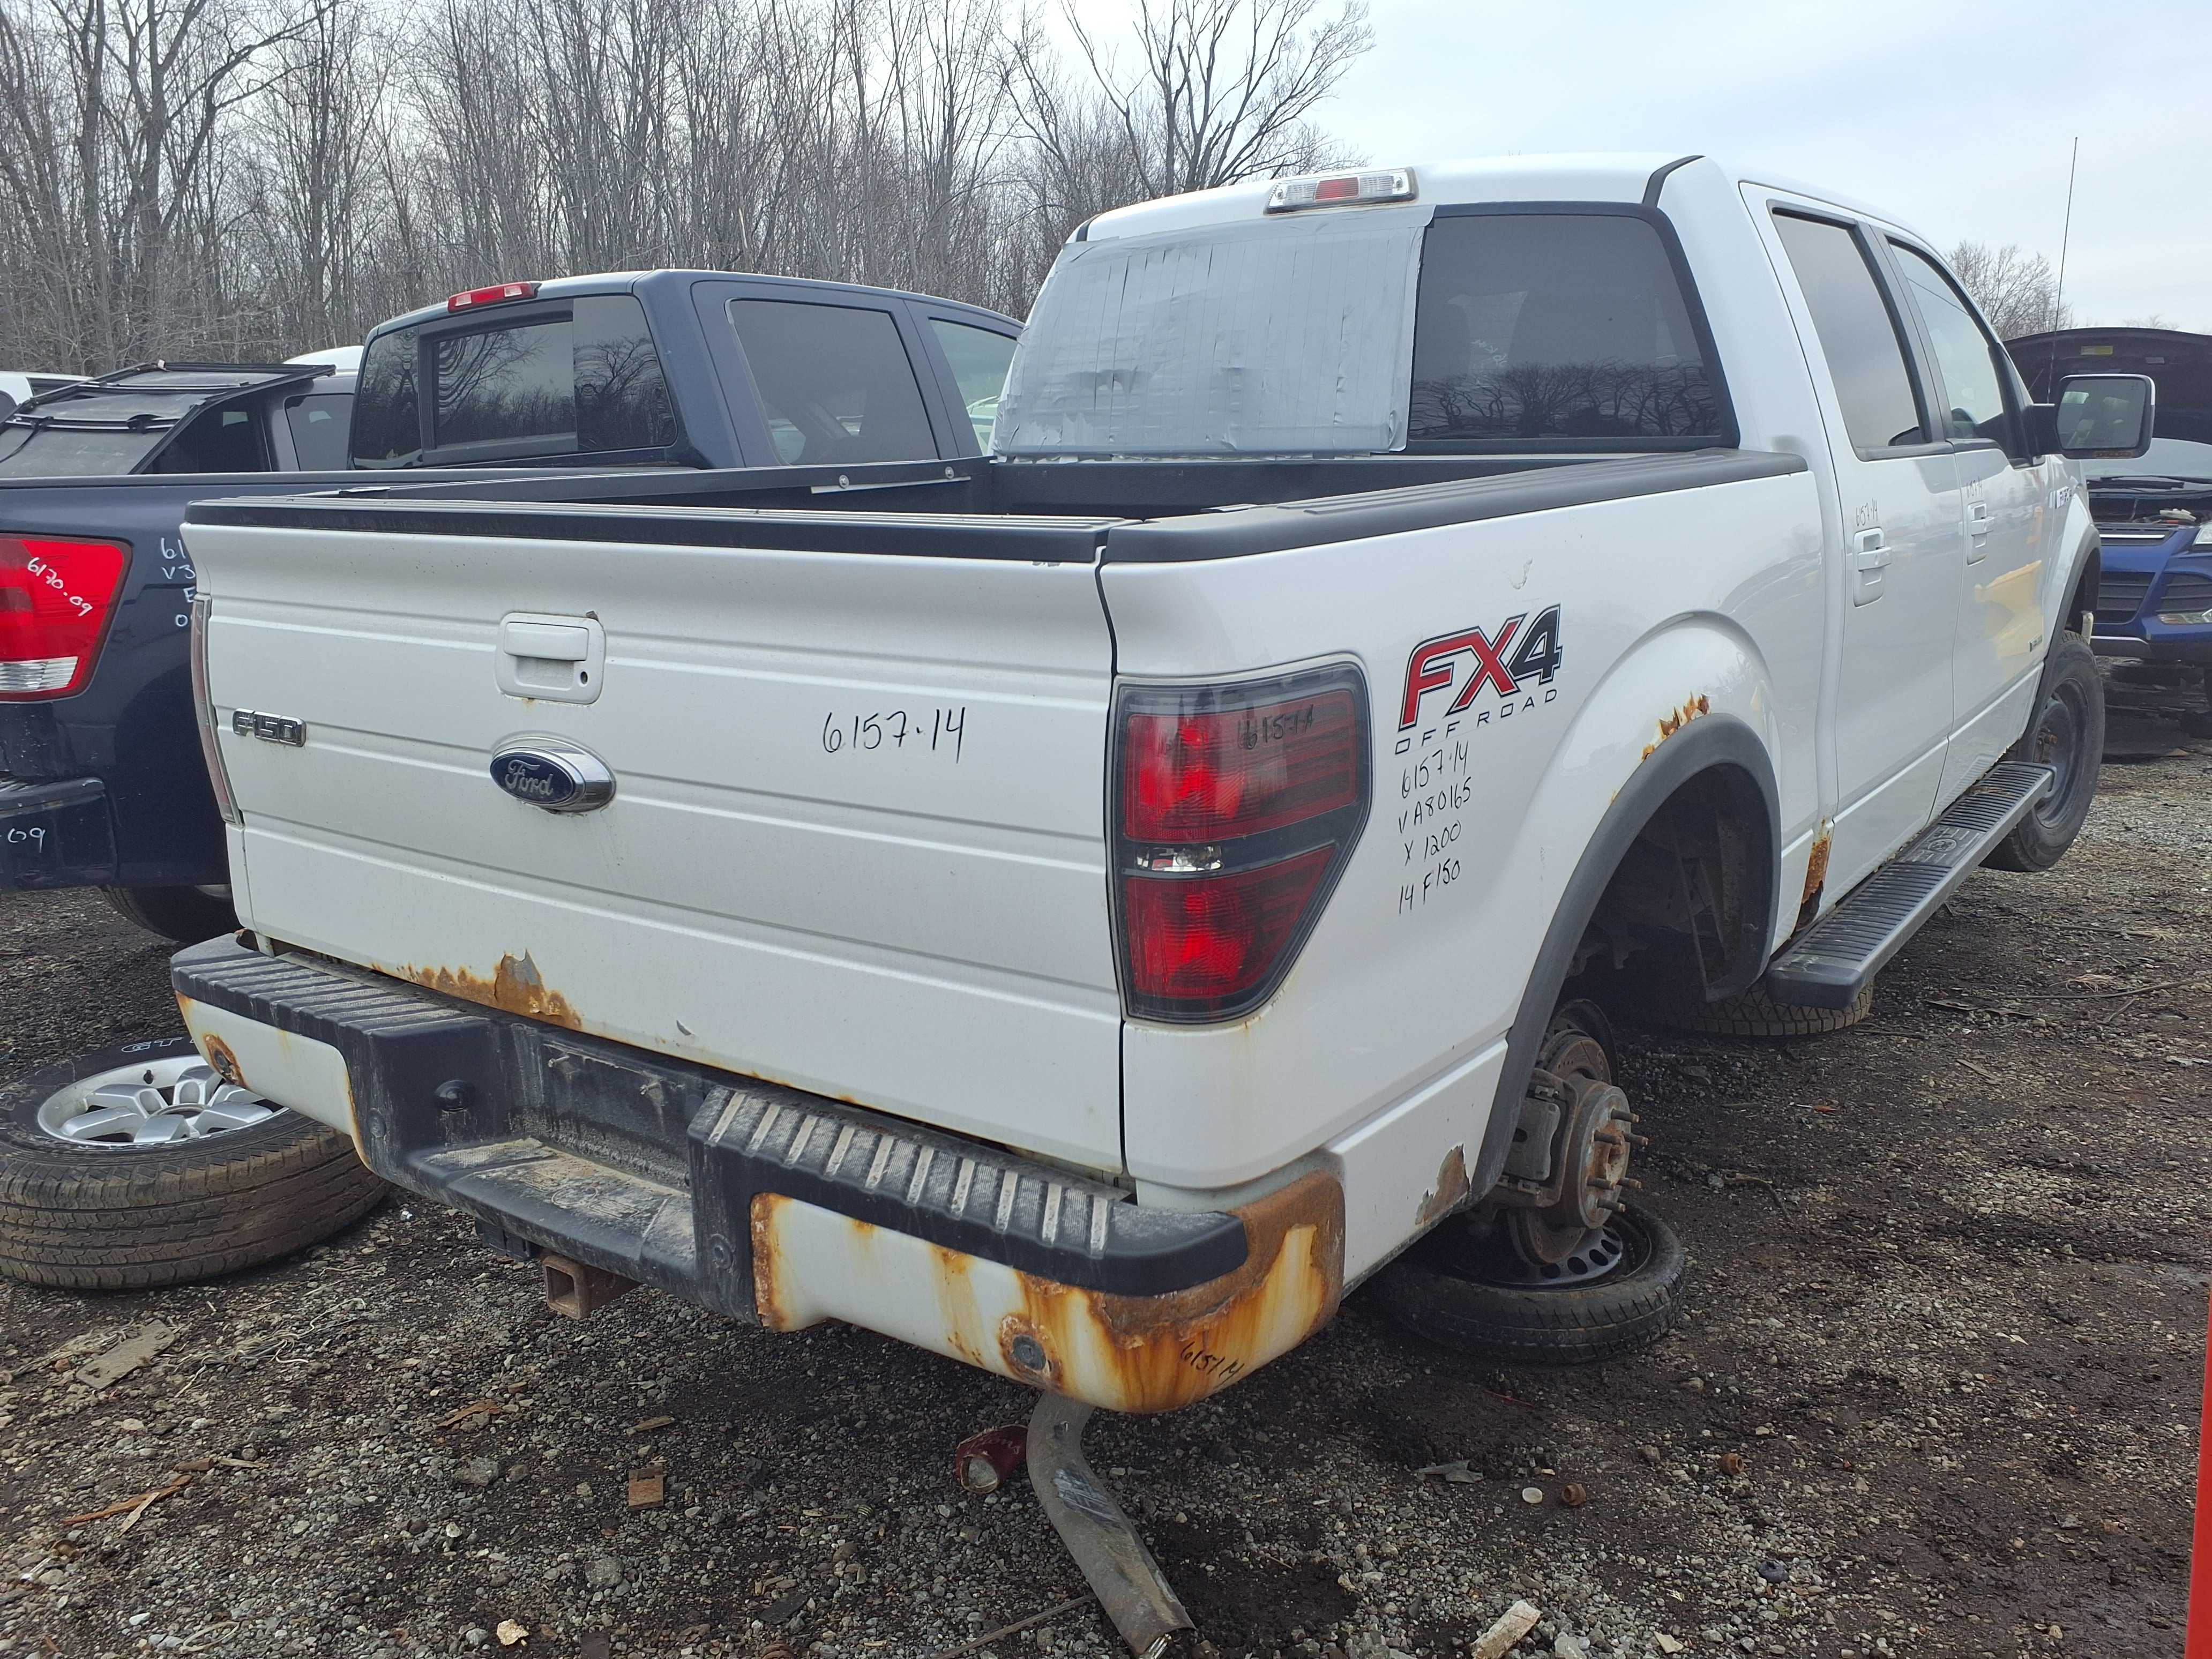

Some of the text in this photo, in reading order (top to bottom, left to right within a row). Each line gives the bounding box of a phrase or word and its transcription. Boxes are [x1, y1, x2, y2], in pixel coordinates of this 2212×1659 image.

[1397, 602, 1563, 733] FX4
[1394, 689, 1557, 756] OFF ROAD
[505, 759, 554, 796] Ford
[121, 1037, 184, 1053] GT
